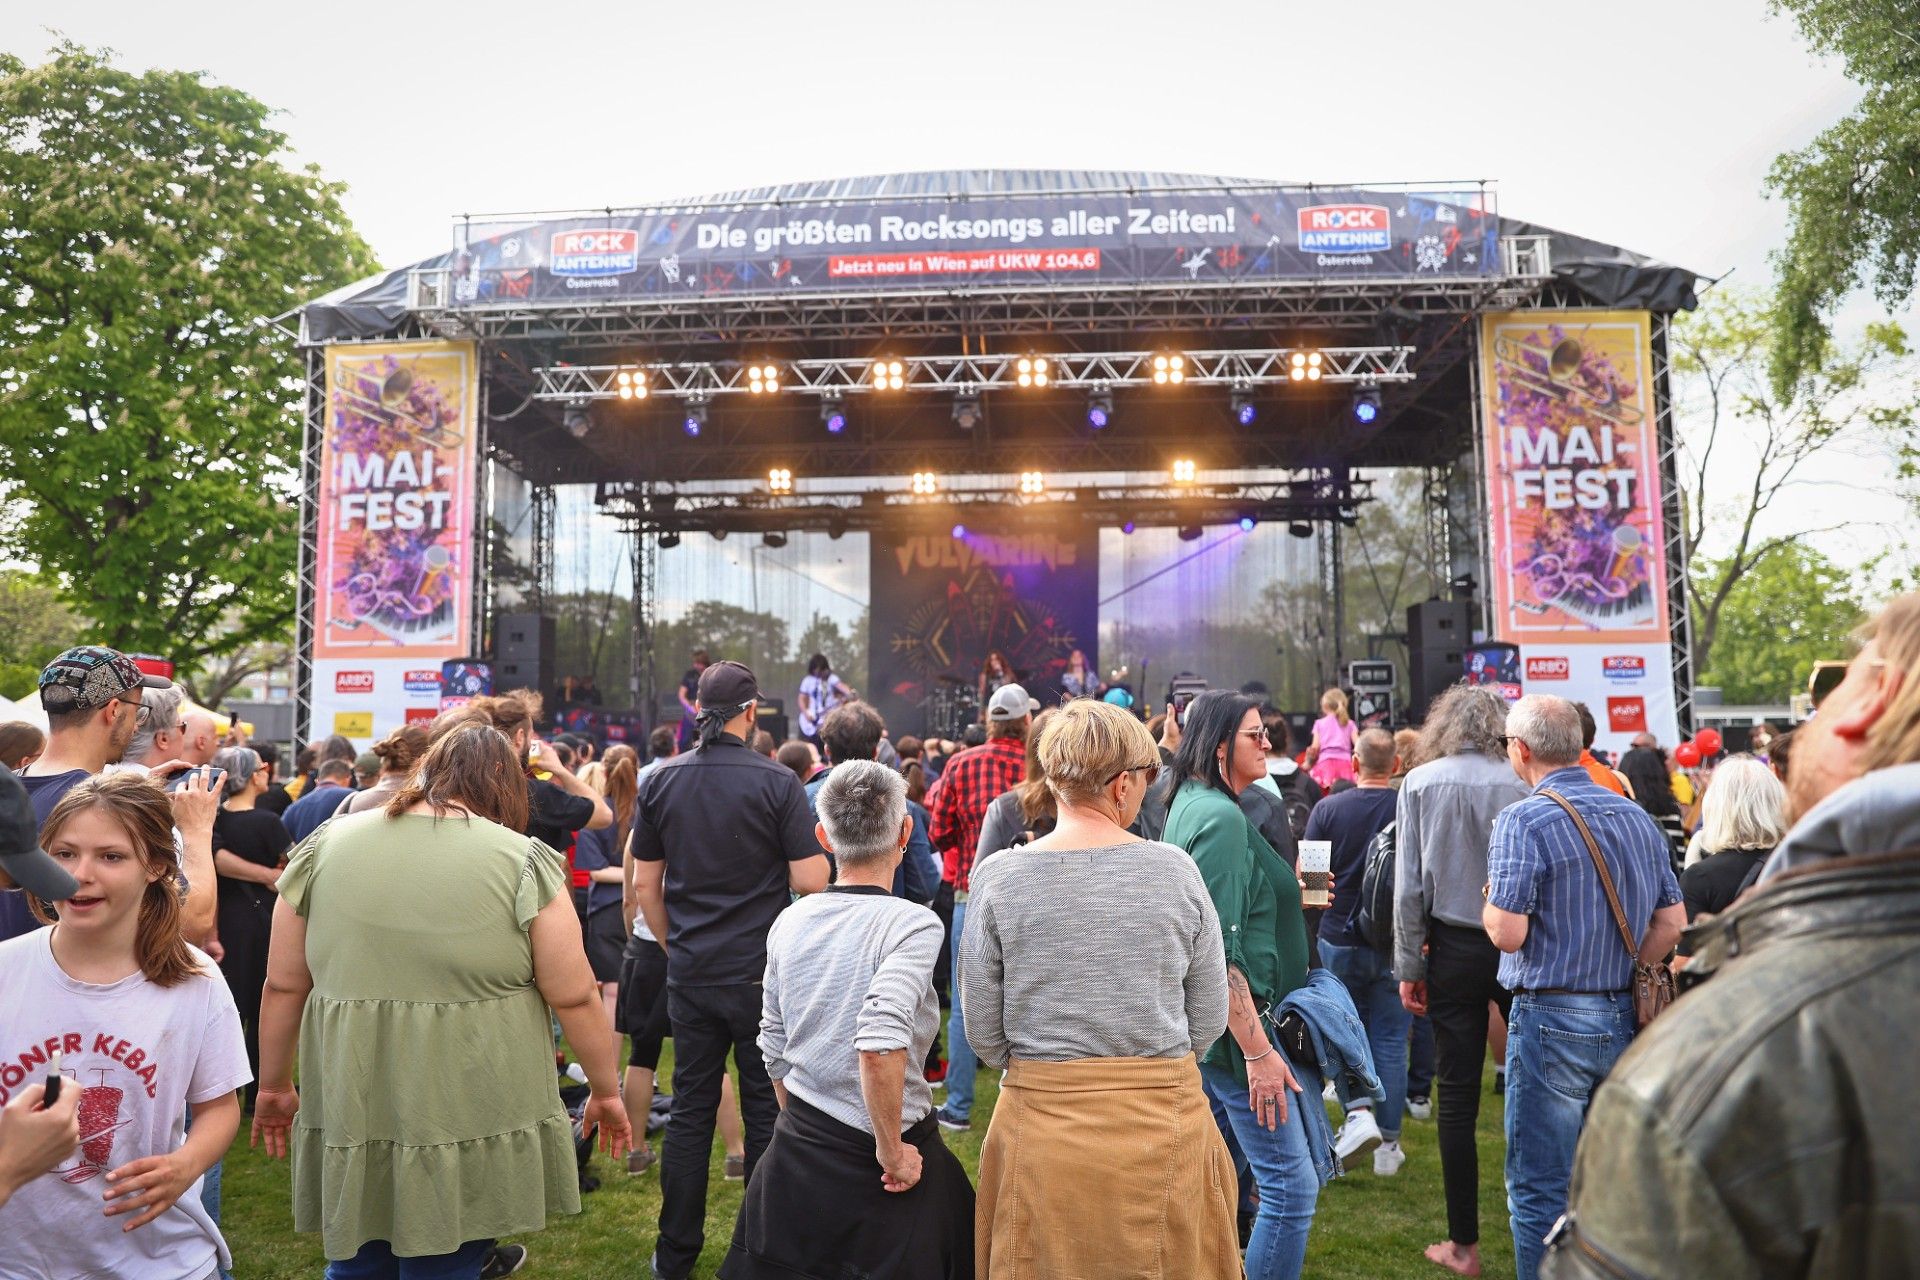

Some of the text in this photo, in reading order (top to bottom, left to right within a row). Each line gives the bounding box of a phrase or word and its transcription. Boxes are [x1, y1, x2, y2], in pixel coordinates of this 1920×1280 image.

[697, 207, 1236, 251] Die größten Rocksongs aller Zeiten!
[1312, 210, 1376, 228] ROCK
[564, 233, 625, 252] ROCK
[1304, 231, 1387, 246] ANTENNE
[555, 254, 633, 270] ANTENNE
[833, 252, 1097, 275] Jetzt neu in Wien auf UKW 104,6
[1317, 254, 1374, 267] Österreich
[1509, 425, 1637, 465] MAI-
[341, 449, 455, 489] MAI-
[1512, 468, 1637, 509] FEST
[339, 490, 452, 532] FEST
